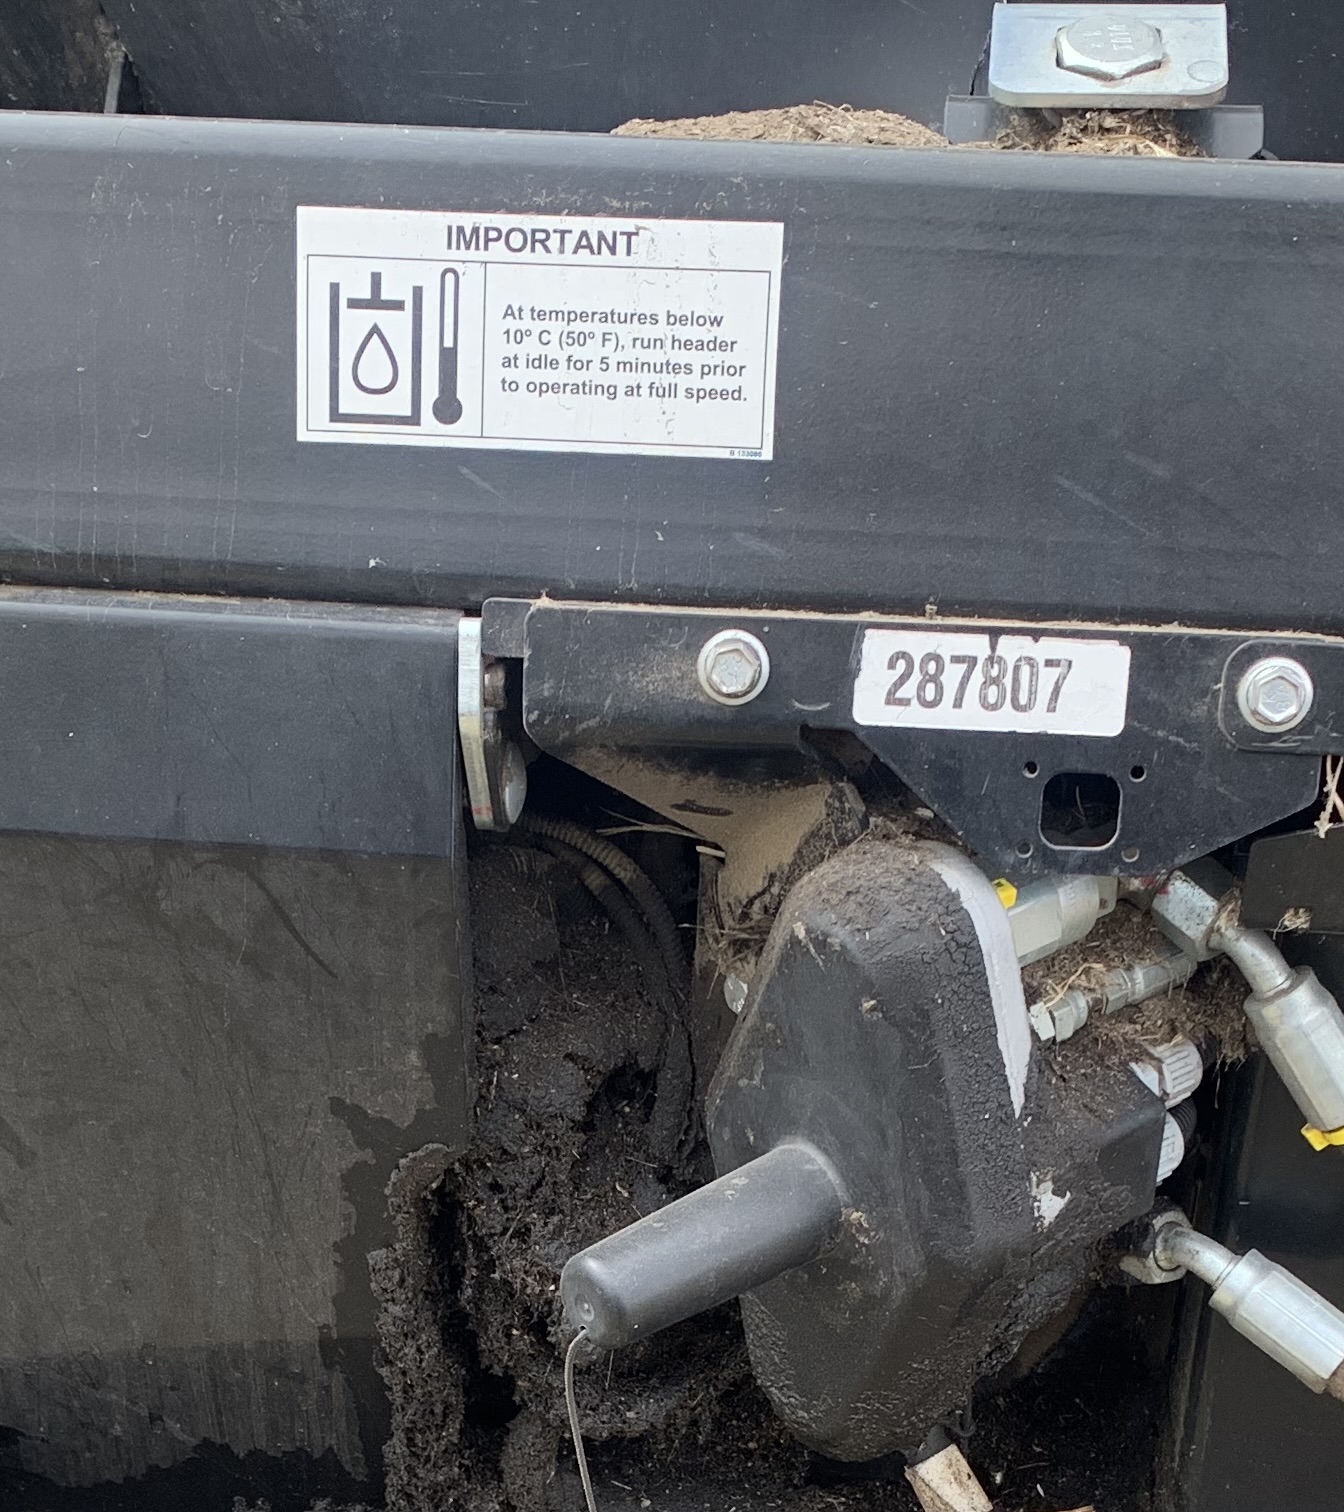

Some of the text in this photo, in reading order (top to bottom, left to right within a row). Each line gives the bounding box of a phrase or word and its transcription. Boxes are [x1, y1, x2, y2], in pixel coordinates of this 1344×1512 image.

[446, 224, 639, 257] IMPORTANT
[502, 304, 724, 327] At temperatures below
[538, 330, 552, 347] C
[601, 331, 625, 352] F),
[632, 335, 664, 351] run
[671, 335, 738, 353] header
[501, 353, 746, 380] at idle for 5 minutes prior
[500, 378, 747, 404] to operating at full speed.
[884, 650, 1073, 713] 287807
